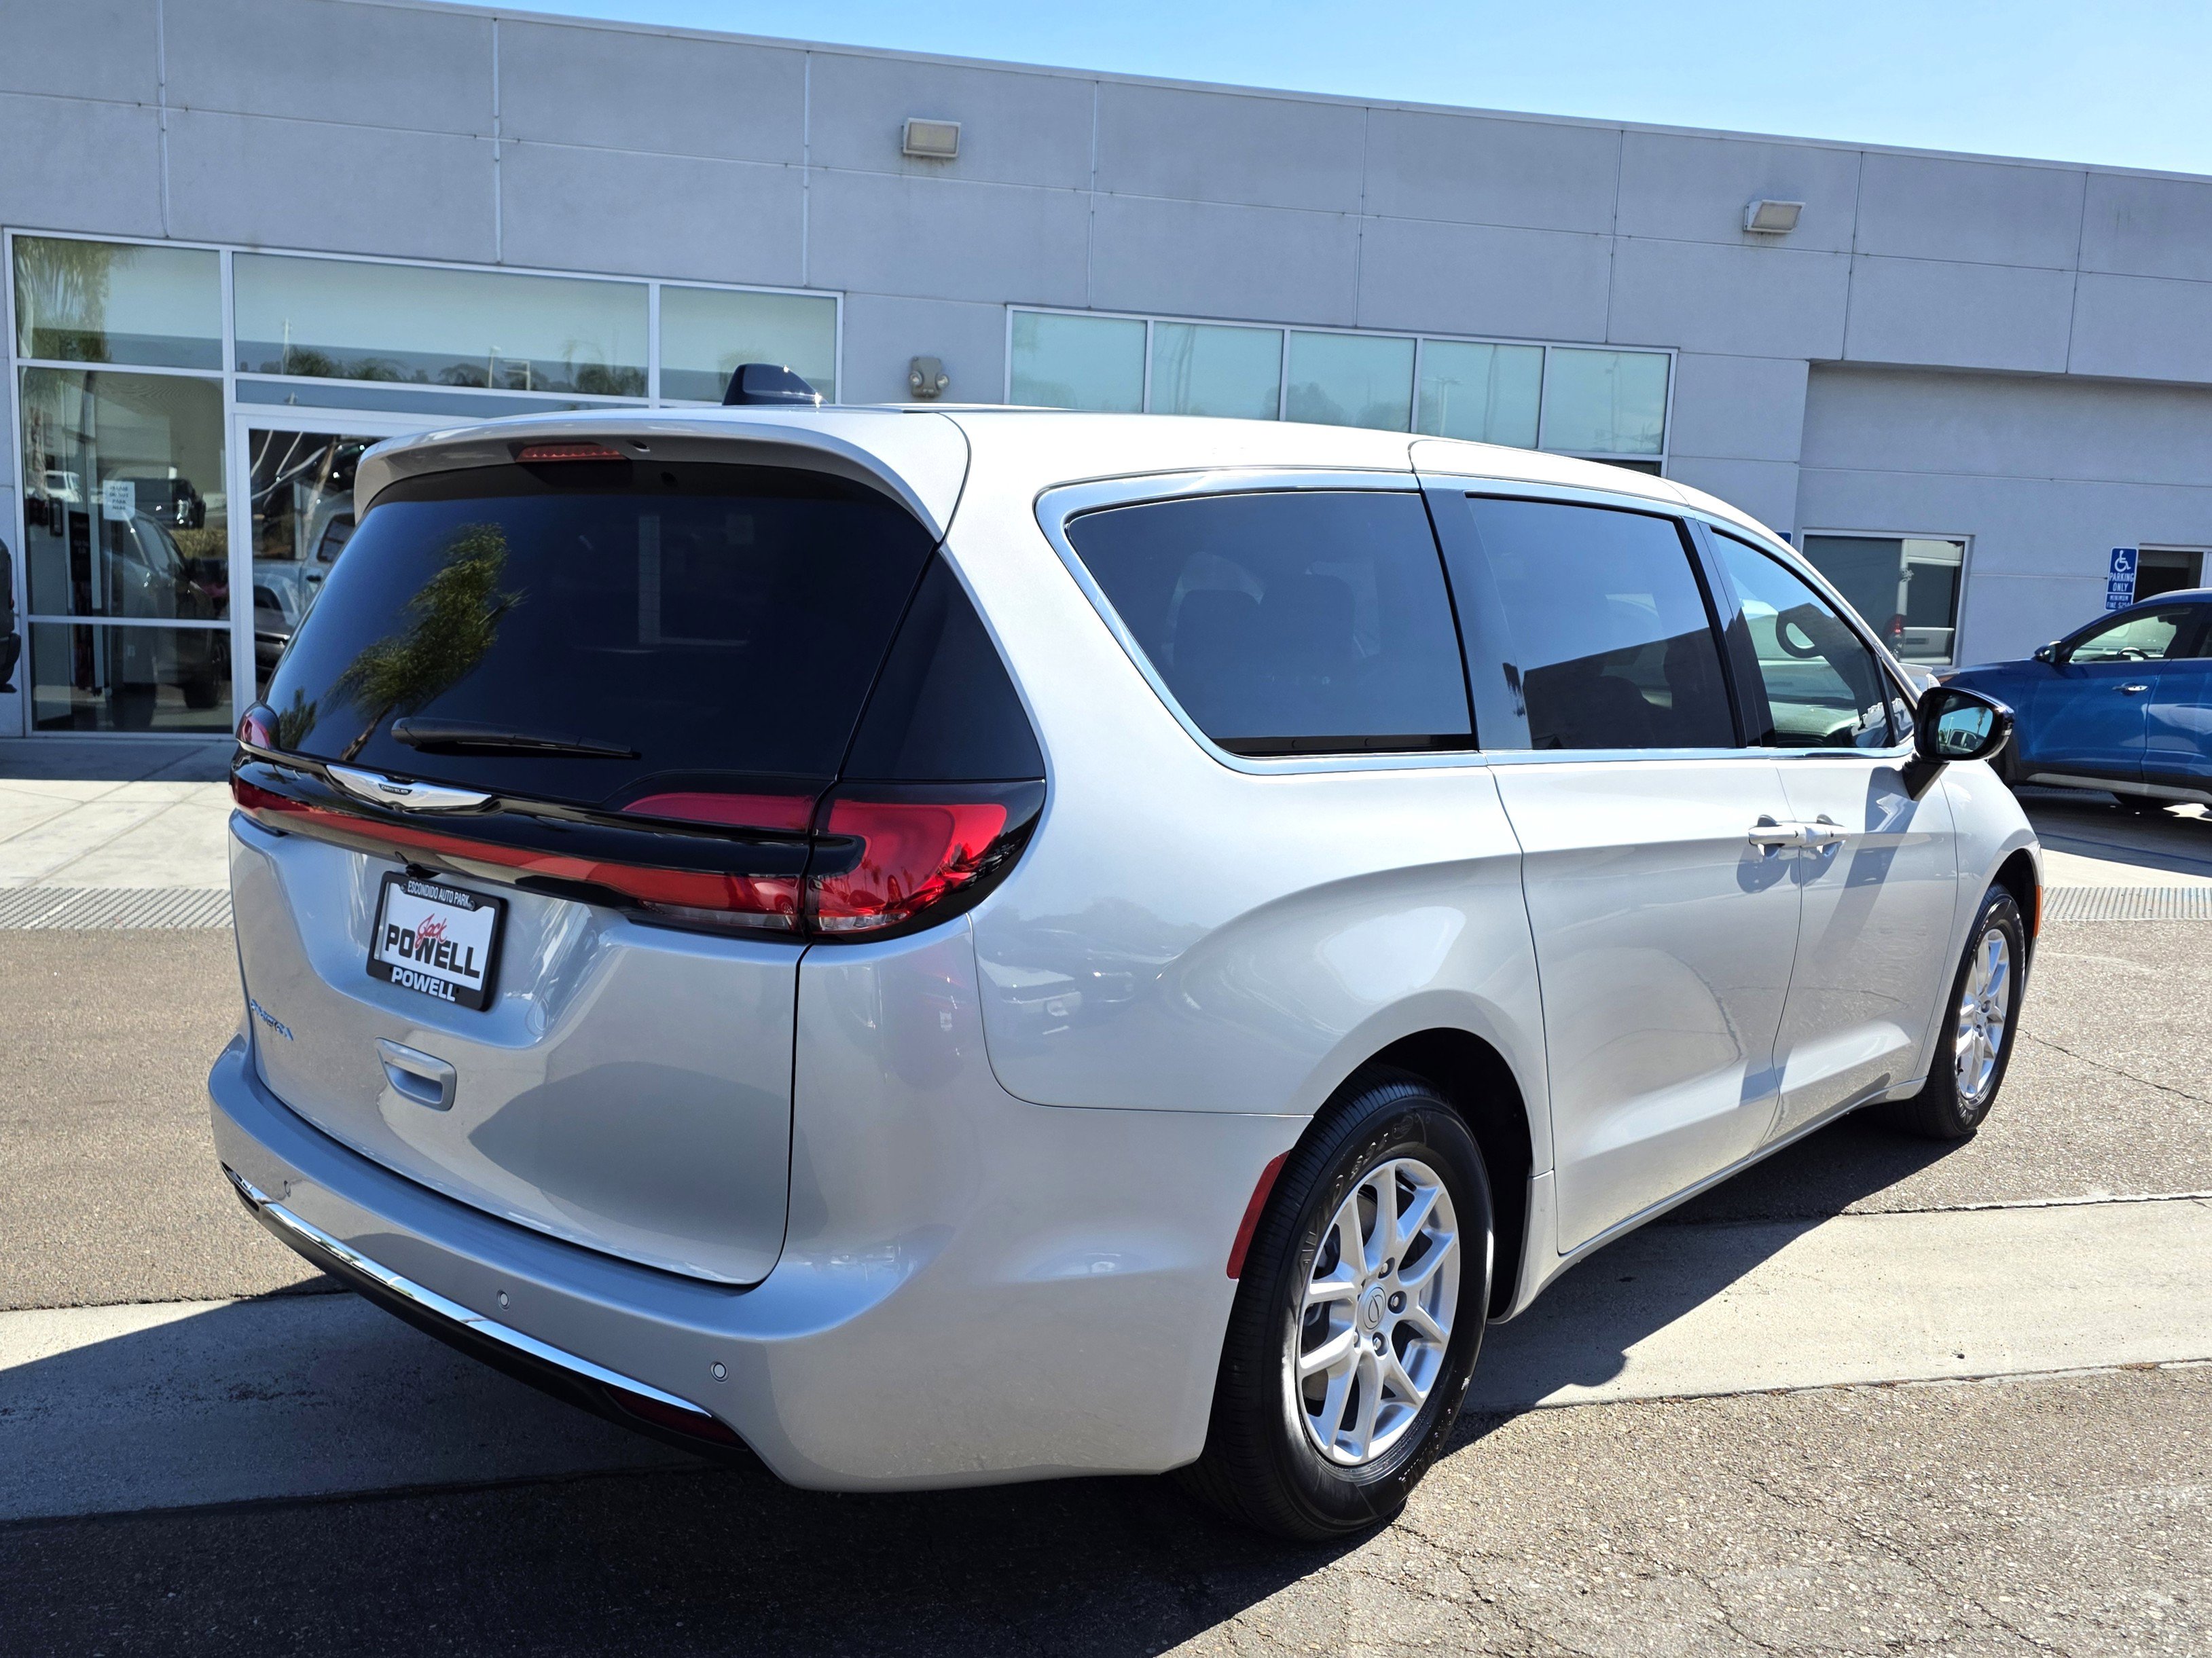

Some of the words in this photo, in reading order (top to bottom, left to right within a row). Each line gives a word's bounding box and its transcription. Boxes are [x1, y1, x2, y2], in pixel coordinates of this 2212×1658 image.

[2109, 572, 2134, 582] PARKING
[2112, 582, 2128, 592] ONLY
[407, 880, 438, 899] ESCONDIDO
[439, 889, 454, 904] AUTO
[454, 893, 471, 907] PARK
[415, 913, 448, 949] Jack
[384, 923, 481, 980] POWELL
[391, 966, 456, 1001] POWELL
